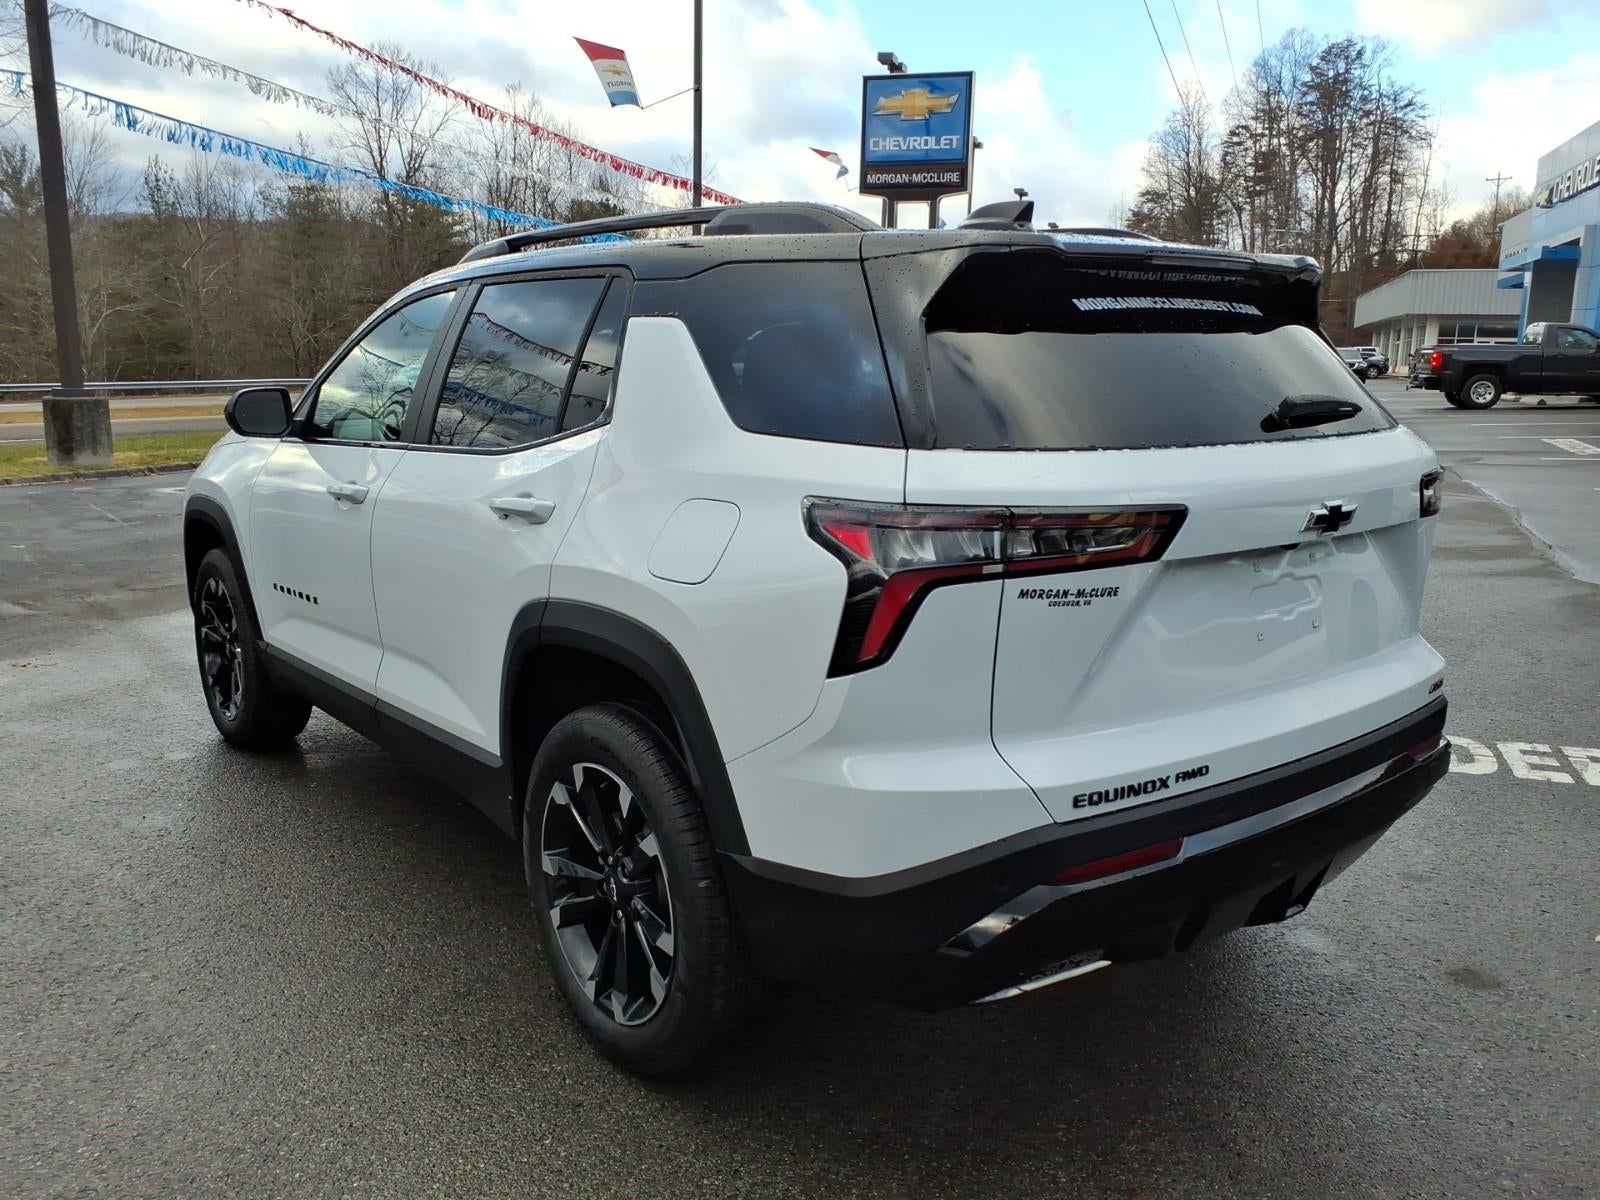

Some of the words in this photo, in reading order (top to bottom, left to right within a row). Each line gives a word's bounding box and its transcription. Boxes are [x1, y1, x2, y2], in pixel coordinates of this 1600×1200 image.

[869, 135, 960, 151] CHEVROLET
[866, 172, 961, 184] MORGAN-MCCLURE
[1017, 586, 1120, 600] MORGAN-McCLURE
[1072, 775, 1171, 808] EQUINOX
[1174, 764, 1210, 784] AWD
